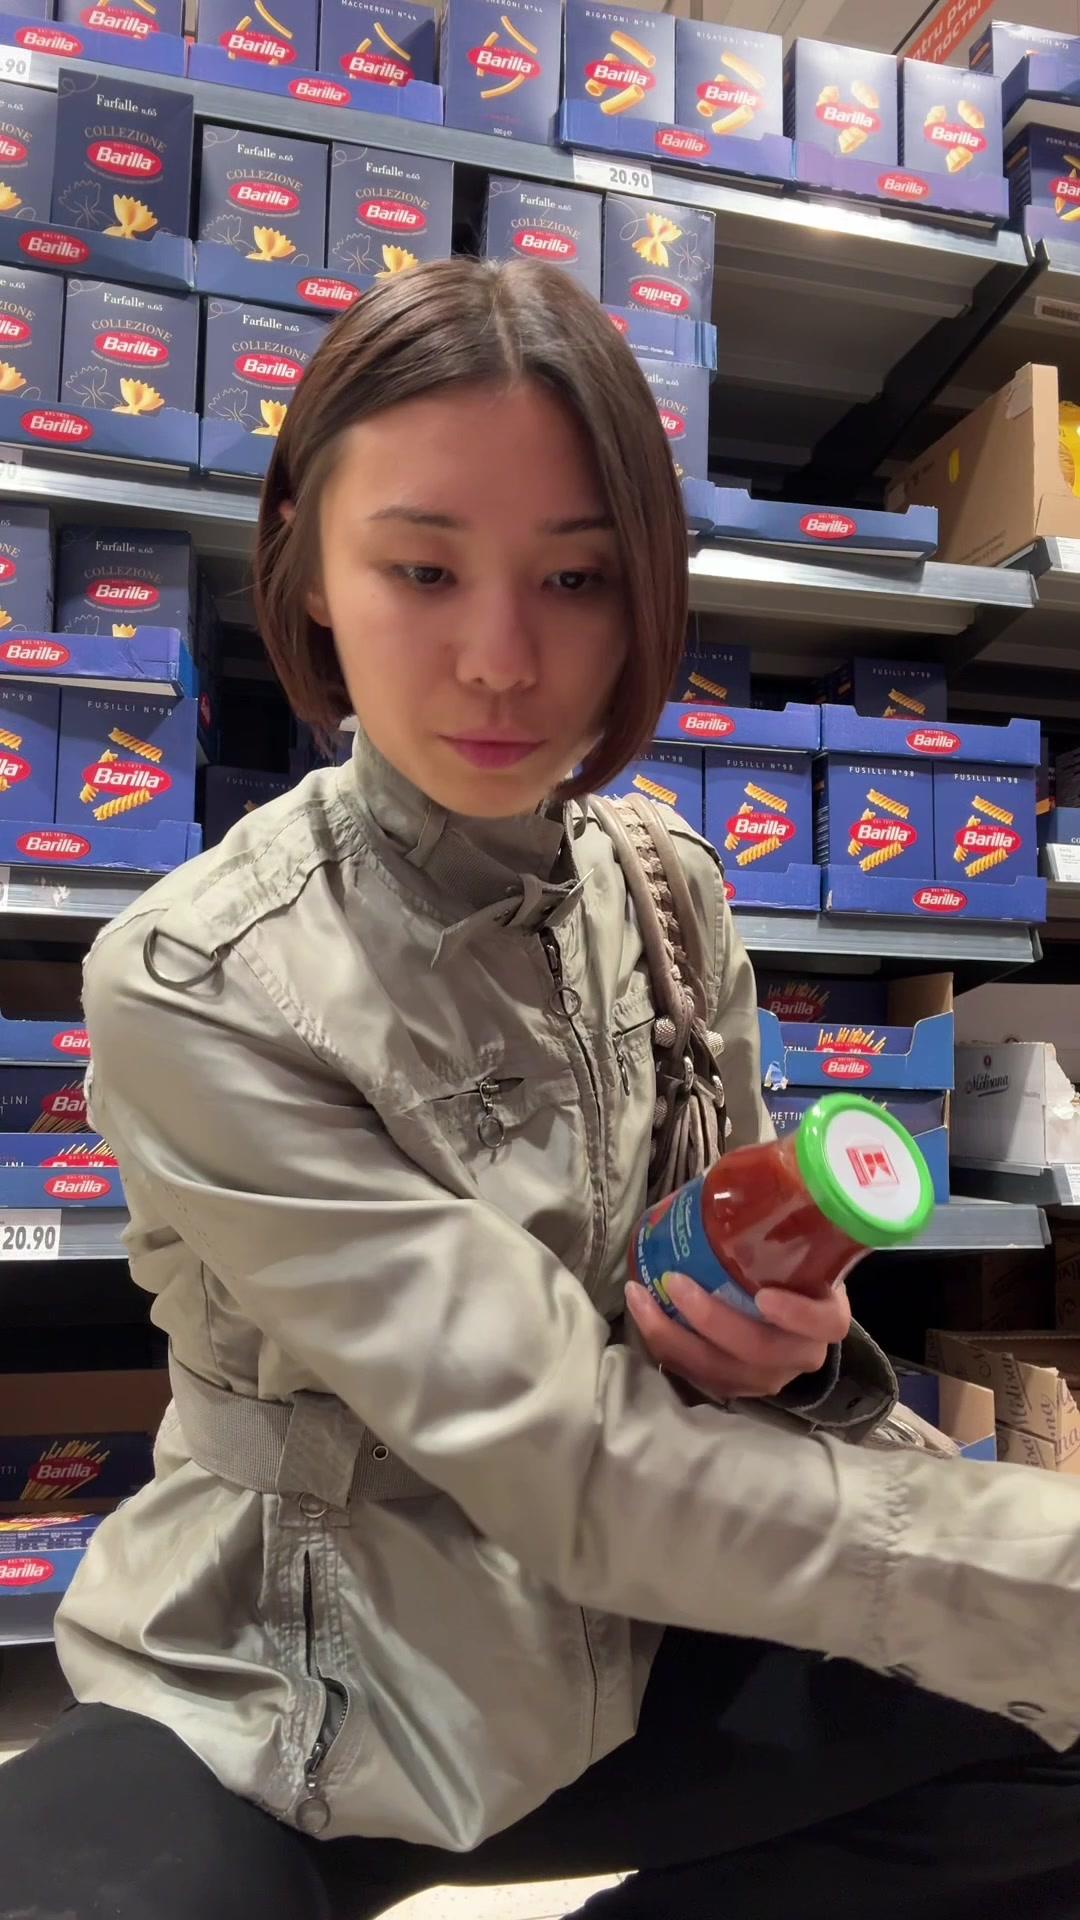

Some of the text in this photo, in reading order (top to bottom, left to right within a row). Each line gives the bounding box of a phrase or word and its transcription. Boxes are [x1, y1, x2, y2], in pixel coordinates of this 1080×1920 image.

[89, 10, 149, 34] Barilla
[585, 11, 629, 23] RIGATONI
[23, 31, 73, 51] Barilla
[228, 34, 287, 58] Barilla
[349, 56, 404, 80] Barilla
[477, 50, 532, 73] Barilla
[594, 65, 648, 86] Barilla
[296, 82, 344, 101] Barilla
[705, 86, 757, 106] Barilla
[96, 94, 139, 113] Farfalle
[823, 107, 874, 128] Barilla
[84, 125, 168, 152] COLLEZIONE
[661, 134, 704, 153] Barilla
[931, 127, 982, 148] Barilla
[96, 147, 153, 170] Barilla
[237, 143, 276, 159] Farfalle
[366, 161, 403, 178] Farfalle
[609, 168, 649, 187] 20.90
[226, 168, 303, 191] COLLEZIONE
[883, 178, 923, 195] Barilla
[237, 186, 290, 206] Barilla
[355, 187, 430, 210] COLLEZIONE
[520, 193, 556, 209] Farfalle
[366, 205, 417, 225] Barilla
[511, 217, 581, 240] COLLEZIONE
[28, 236, 81, 258] Barilla
[521, 234, 569, 253] Barilla
[103, 292, 145, 308] Farfalle
[304, 282, 353, 301] Barilla
[638, 285, 682, 307] Barilla
[91, 319, 173, 343] COLLEZIONE
[242, 314, 300, 333] Farfalle n.65
[103, 336, 158, 358] Barilla
[243, 358, 296, 379] Barilla
[30, 415, 83, 436] Barilla
[806, 519, 850, 534] Barilla
[95, 540, 135, 554] Farfalle
[84, 565, 164, 584] COLLEZIONE
[95, 584, 150, 600] Barilla
[6, 645, 61, 661] Barilla
[2, 693, 33, 702] N°98
[87, 700, 173, 717] FUSILLI N°98
[685, 718, 728, 731] Barilla
[913, 734, 954, 748] Barilla
[727, 759, 765, 769] FUSILLI
[849, 766, 915, 777] FUSILLI N°98
[93, 767, 160, 789] Barilla
[954, 773, 1019, 785] FUSILLI N°98
[735, 818, 787, 836] Barilla
[858, 825, 908, 842] Barilla
[26, 836, 81, 853] Barilla
[963, 832, 1014, 848] Barilla
[920, 892, 961, 906] Barilla
[769, 1000, 814, 1015] Barilla
[827, 1061, 865, 1074] Barilla
[52, 1180, 102, 1193] Barilla
[2, 1226, 56, 1250] 20.90
[37, 1464, 91, 1479] Barilla
